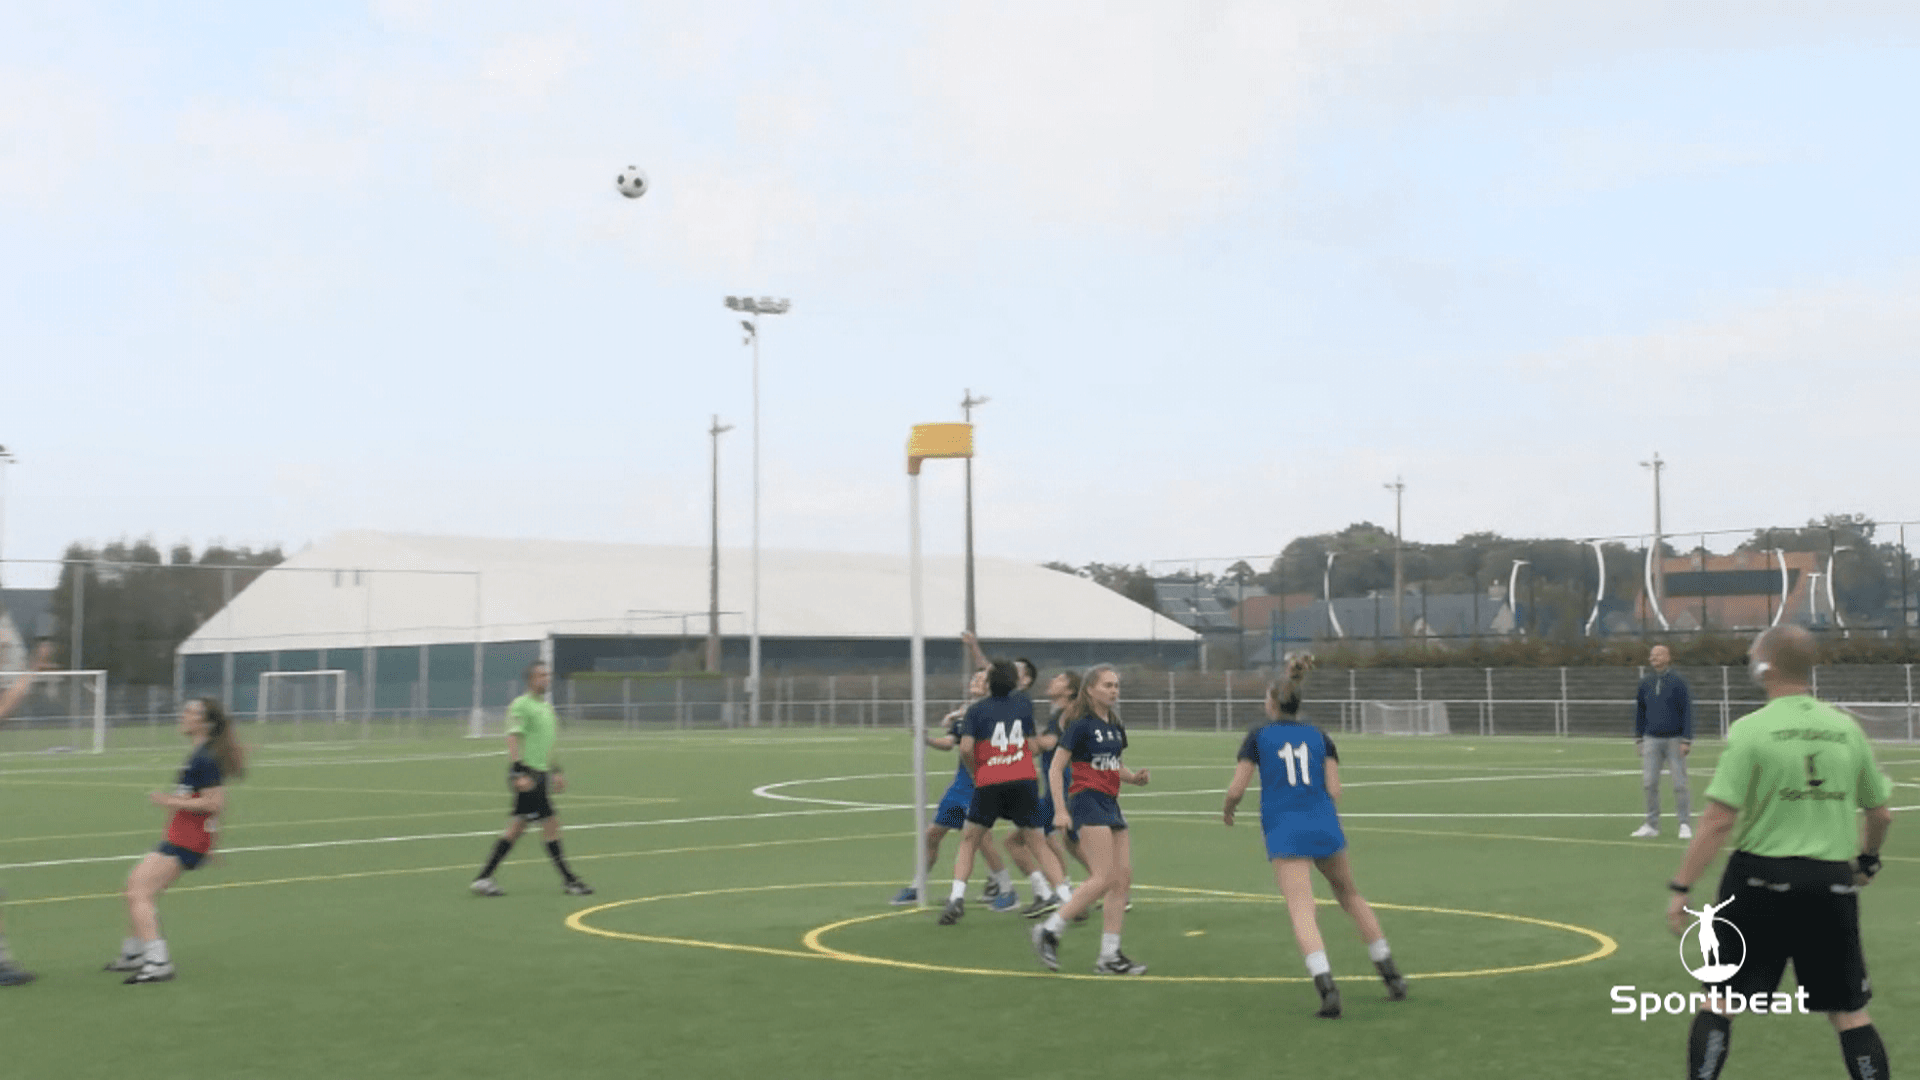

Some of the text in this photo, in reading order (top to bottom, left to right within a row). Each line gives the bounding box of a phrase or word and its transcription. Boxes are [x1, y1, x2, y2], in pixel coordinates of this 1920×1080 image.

[991, 719, 1025, 752] 44
[1094, 729, 1104, 743] 3
[1278, 741, 1310, 787] 11
